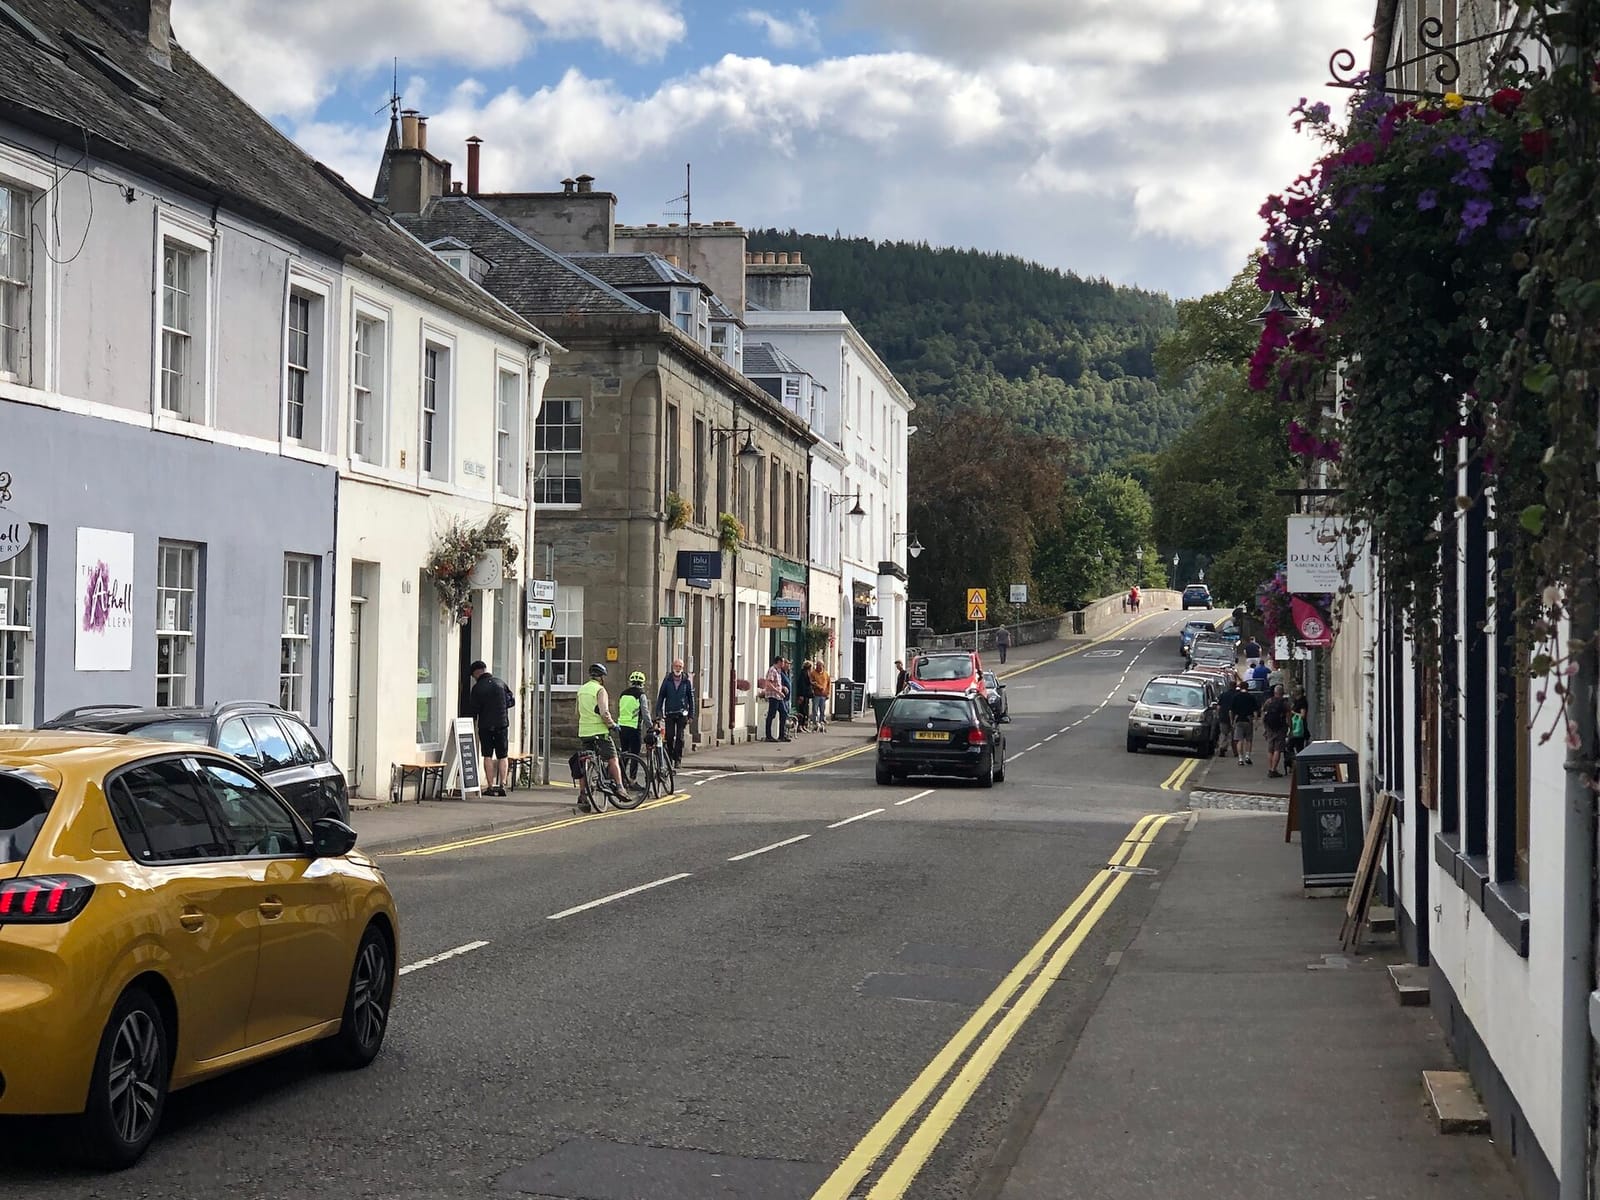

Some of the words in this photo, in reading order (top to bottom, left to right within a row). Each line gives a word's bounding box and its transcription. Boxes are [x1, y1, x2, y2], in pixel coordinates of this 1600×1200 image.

[1290, 553, 1362, 562] DUNKED
[89, 568, 132, 625] Atholl
[856, 628, 882, 636] BISTRO
[1312, 798, 1348, 809] LITTER
